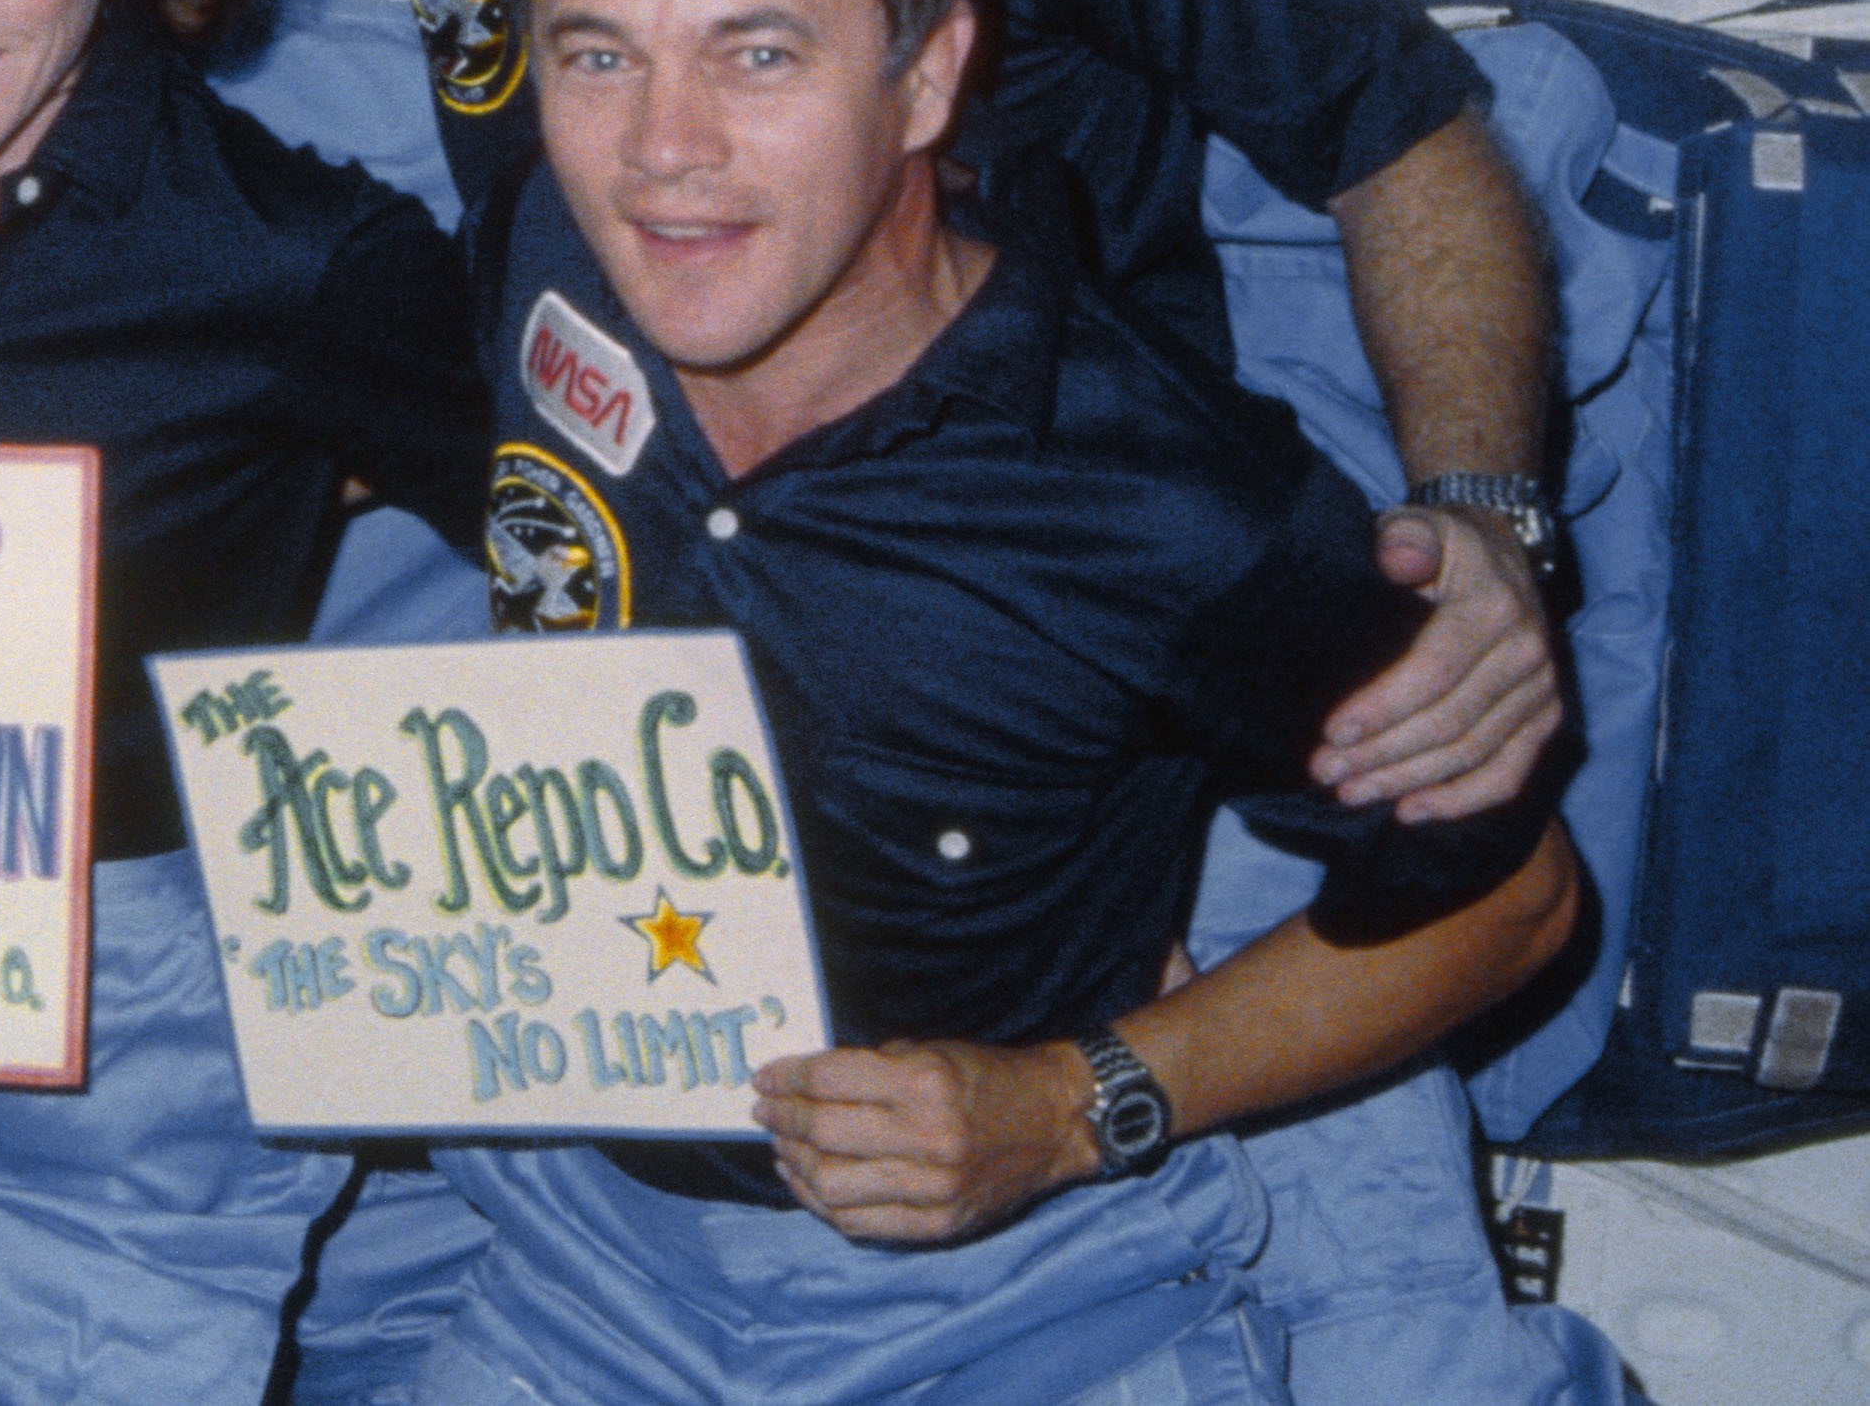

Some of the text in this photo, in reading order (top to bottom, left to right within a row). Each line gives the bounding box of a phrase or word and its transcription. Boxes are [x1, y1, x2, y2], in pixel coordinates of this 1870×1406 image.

[527, 326, 633, 447] NASA
[180, 668, 294, 745] THE
[239, 688, 790, 925] Ace Repo Co.
[468, 1012, 568, 1102] NO
